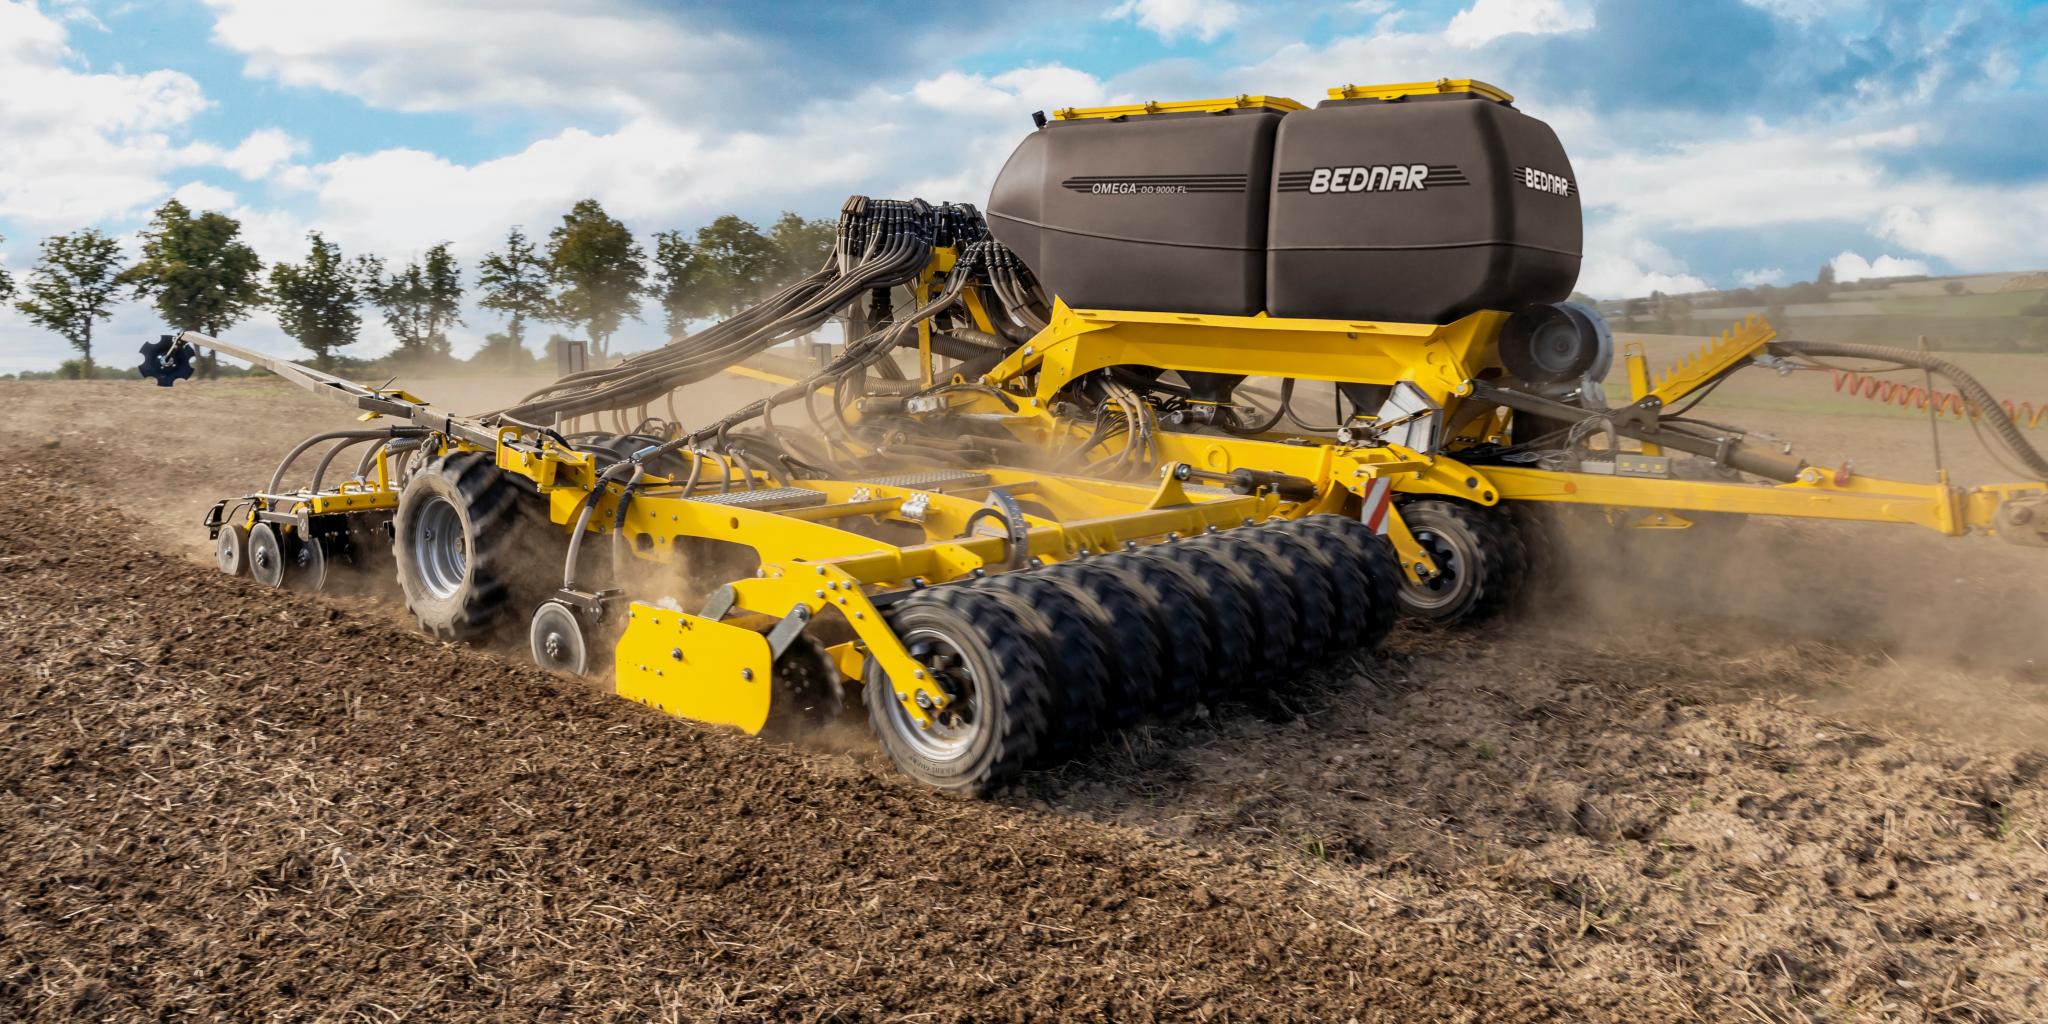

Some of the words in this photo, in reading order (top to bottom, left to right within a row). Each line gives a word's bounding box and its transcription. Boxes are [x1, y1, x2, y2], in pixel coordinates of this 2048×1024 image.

[1092, 182, 1137, 194] OMEGA
[1155, 185, 1175, 194] 9000
[1176, 185, 1188, 194] FL
[1309, 164, 1428, 193] BEDNAR
[1525, 167, 1568, 197] BEDNAR
